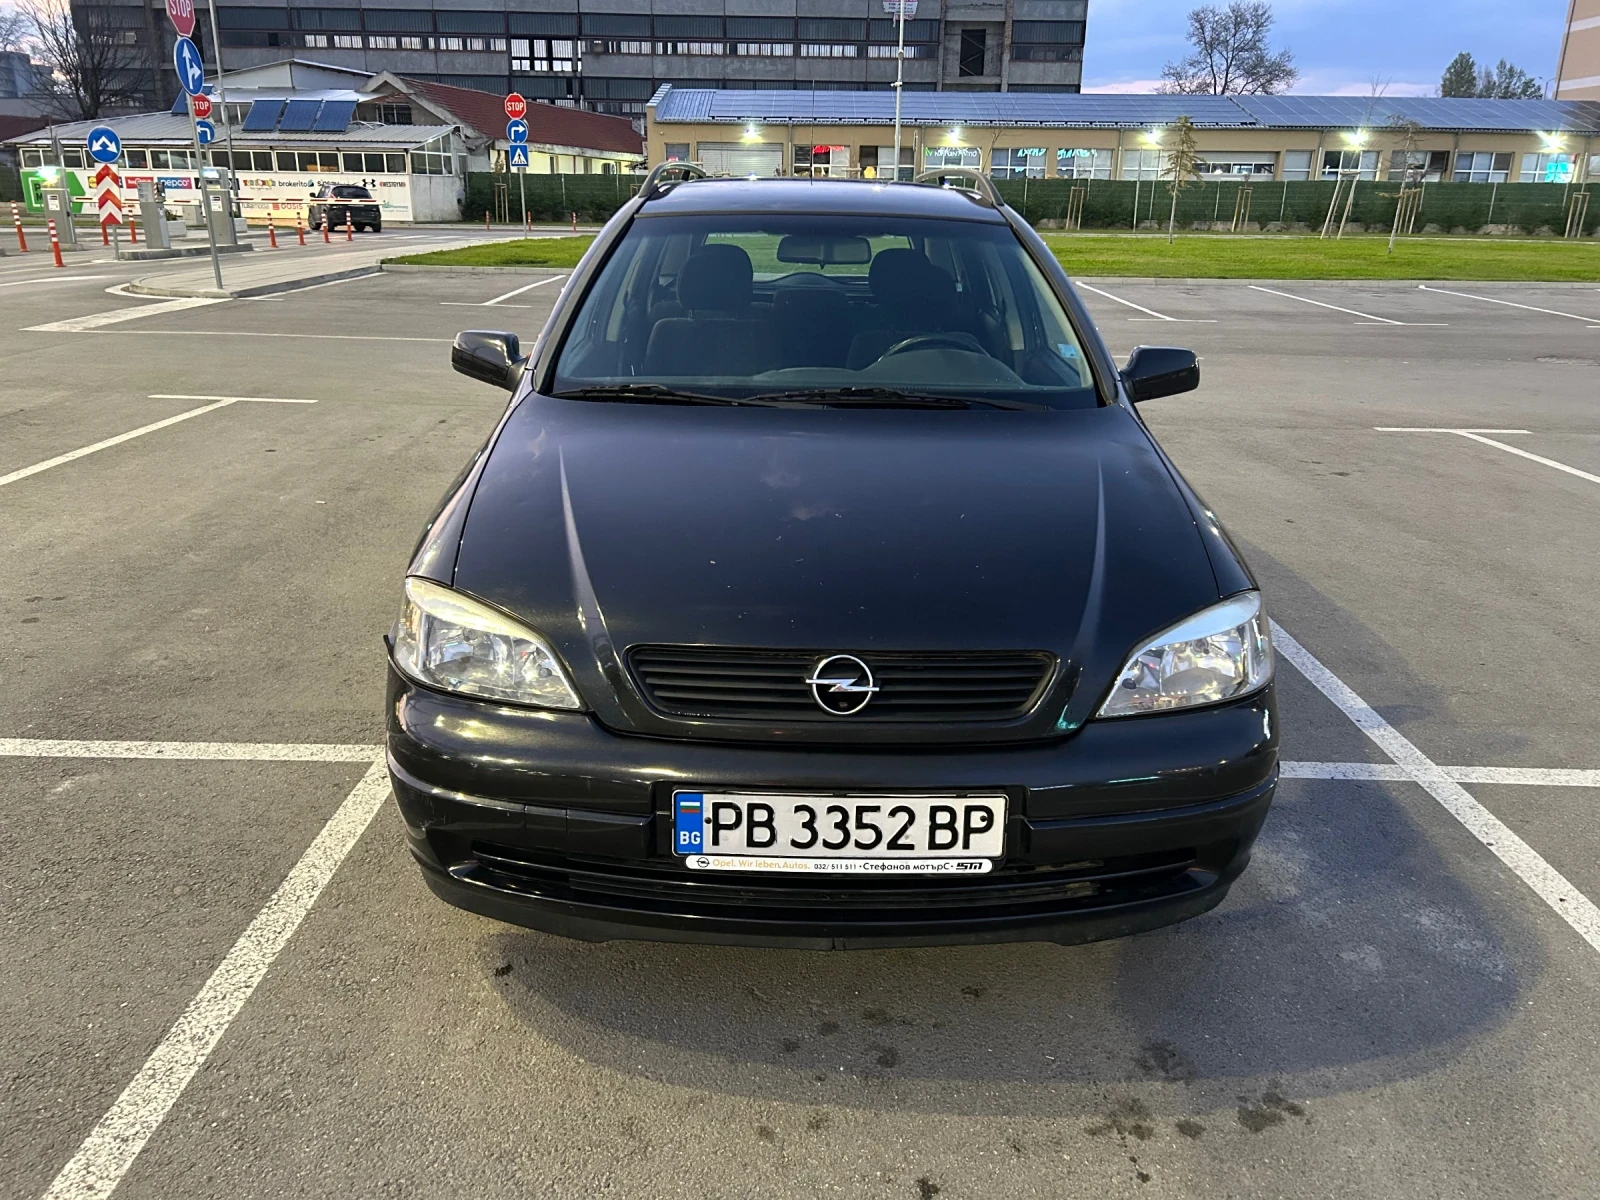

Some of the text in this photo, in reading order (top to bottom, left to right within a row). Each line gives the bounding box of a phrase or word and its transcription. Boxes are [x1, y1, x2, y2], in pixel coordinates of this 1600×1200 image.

[169, 0, 191, 18] STOP
[193, 101, 210, 111] TOP
[507, 102, 524, 111] STOP
[278, 178, 307, 187] brokerito
[711, 801, 994, 851] PB 3352 BP
[680, 831, 701, 845] BG
[712, 858, 736, 868] Opel.
[738, 859, 753, 867] Wir
[782, 861, 810, 870] Autos.
[831, 863, 843, 871] 511
